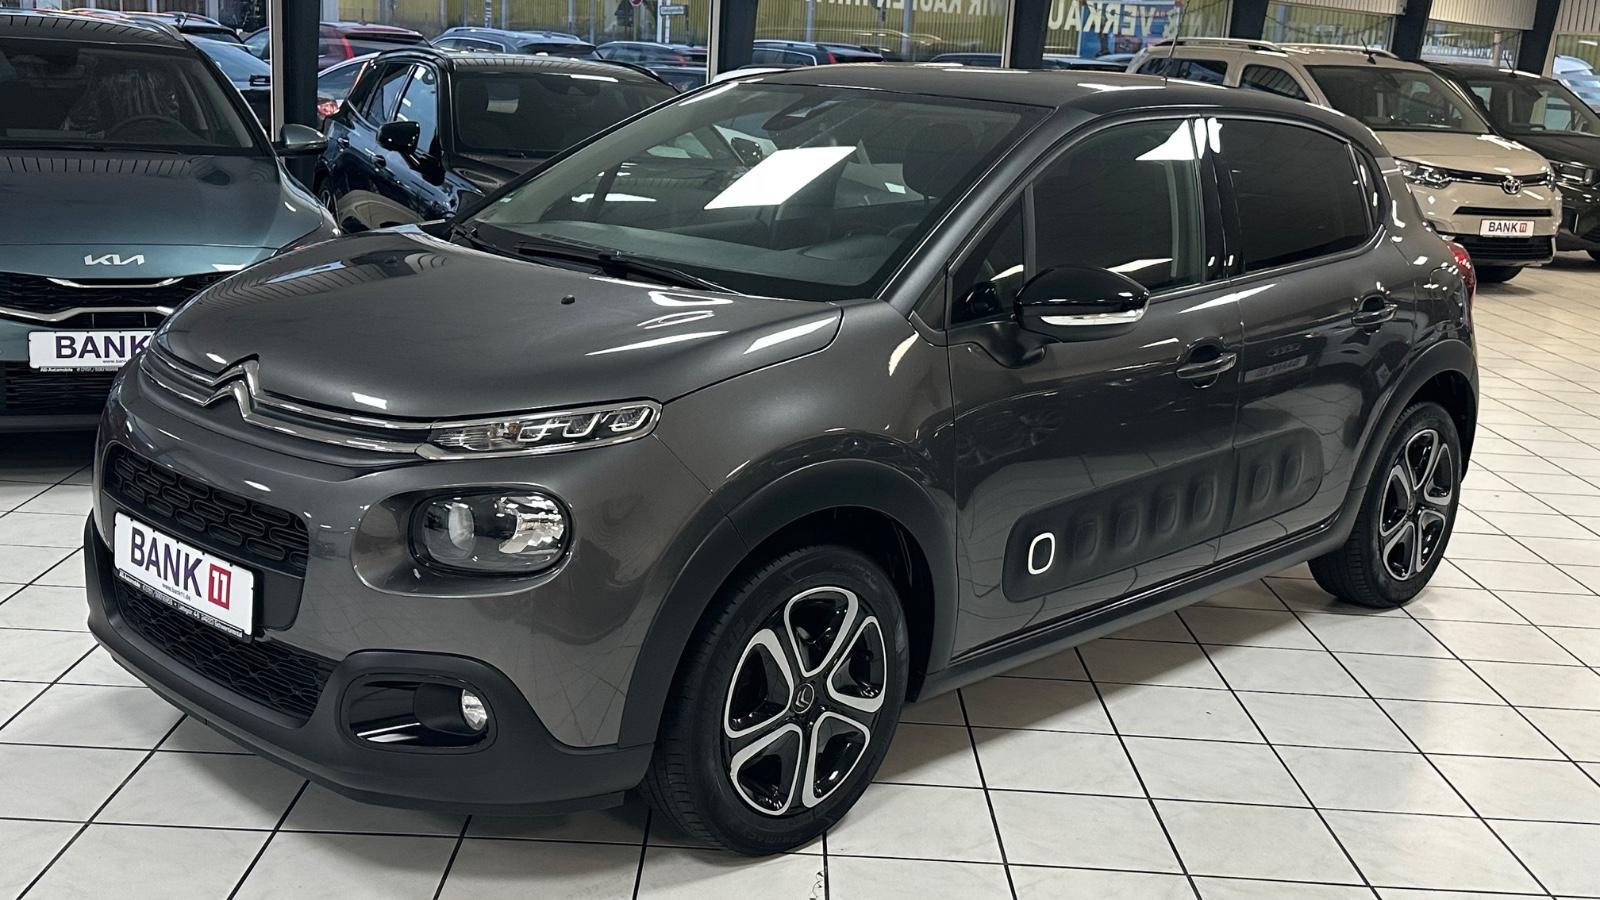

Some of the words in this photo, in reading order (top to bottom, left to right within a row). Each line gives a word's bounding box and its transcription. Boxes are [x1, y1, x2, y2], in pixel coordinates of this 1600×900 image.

[1488, 221, 1518, 232] BANK
[84, 254, 145, 266] KIA
[55, 335, 151, 359] BANK
[130, 527, 203, 598] BANK
[210, 569, 229, 606] 11
